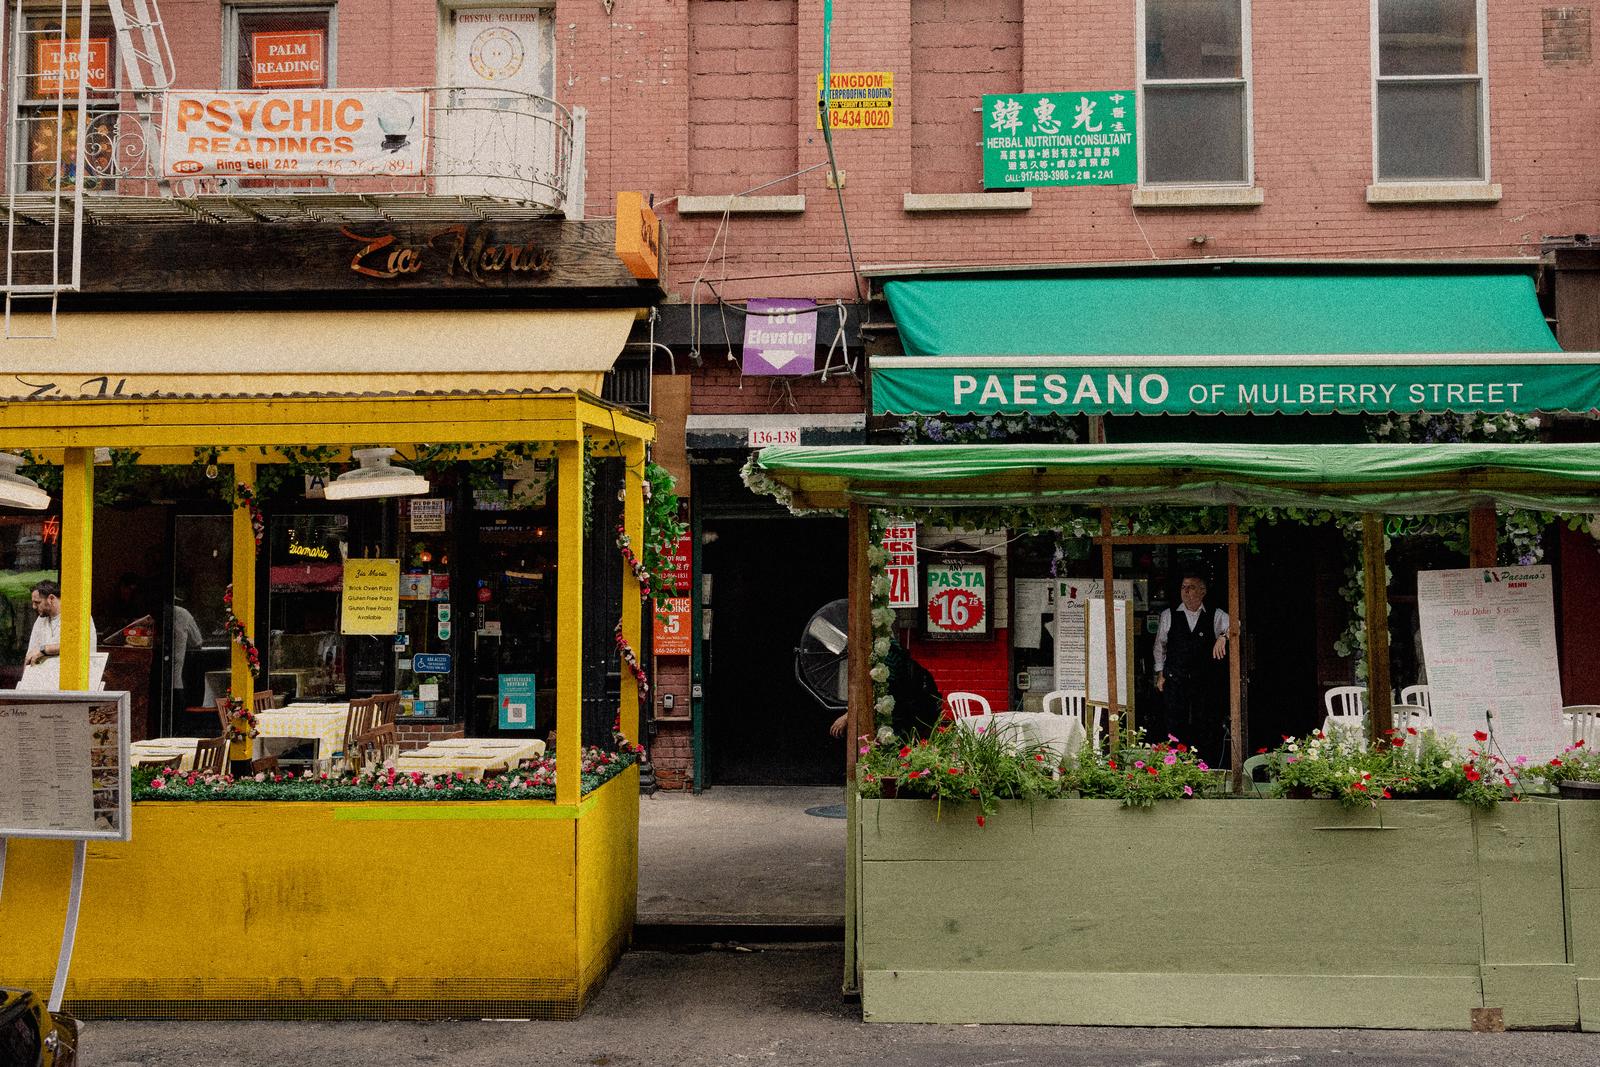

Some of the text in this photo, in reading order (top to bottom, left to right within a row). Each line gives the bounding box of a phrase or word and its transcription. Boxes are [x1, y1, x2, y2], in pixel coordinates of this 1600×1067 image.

[459, 13, 537, 23] CRYSTAL GALLERY
[269, 43, 307, 56] PALM
[42, 68, 105, 80] READNG
[257, 60, 320, 75] READING
[830, 75, 883, 88] KINGDOM
[820, 88, 892, 99] WTERPROOFING ROOFING
[177, 98, 364, 133] PSYCHIC
[828, 110, 889, 126] 18-434 0020
[187, 137, 354, 154] READINGS
[987, 133, 1132, 149] HERBAL NUTRITION CONSULTANT
[216, 160, 242, 172] Ring
[247, 159, 269, 170] Bell
[274, 160, 298, 169] 2A2
[341, 224, 552, 283] Zia Maria
[748, 329, 812, 346] Elevator
[953, 373, 1523, 405] PAESANO OF MULBERRY STREET
[752, 431, 797, 444] 136-138
[885, 528, 915, 538] BEST
[928, 572, 985, 587] PASTA
[1501, 570, 1545, 581] Paesano's
